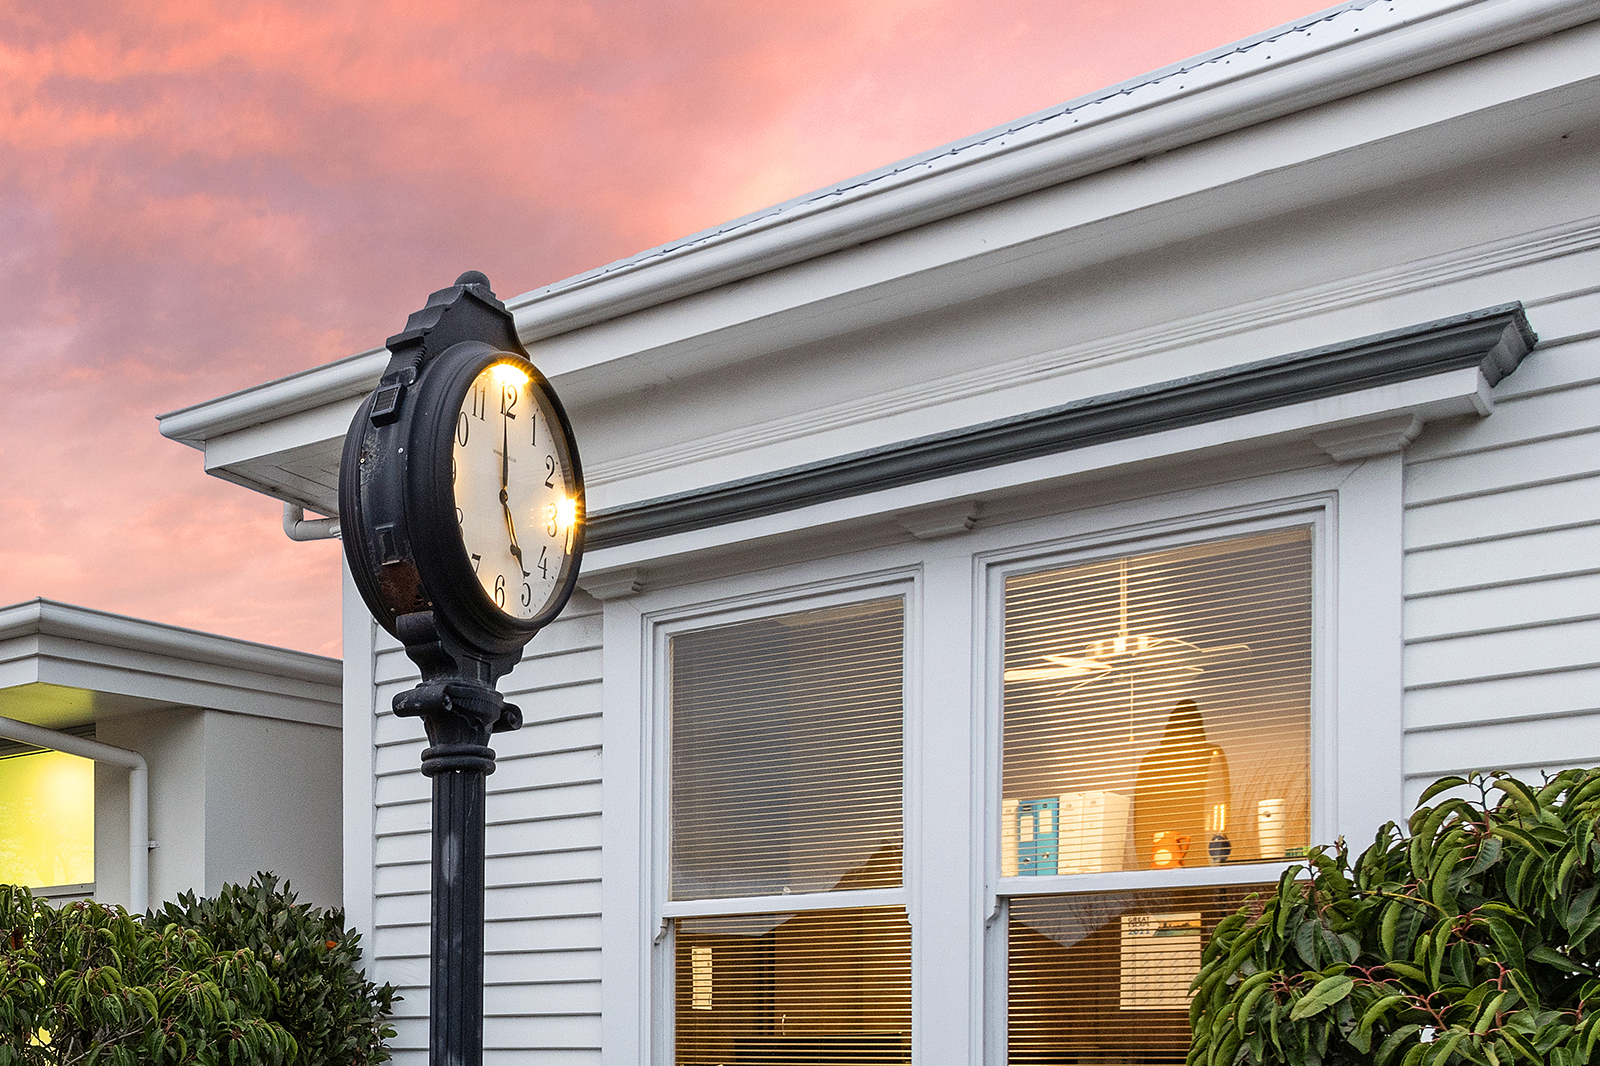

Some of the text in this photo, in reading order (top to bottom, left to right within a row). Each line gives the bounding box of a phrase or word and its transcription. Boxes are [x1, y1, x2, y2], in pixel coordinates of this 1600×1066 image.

[472, 384, 485, 421] 11
[500, 382, 517, 420] 12
[455, 411, 469, 447] 0
[531, 414, 536, 446] 1
[545, 455, 555, 489] 2
[547, 502, 558, 537] 3
[537, 545, 548, 579] 4
[495, 574, 505, 608] 6
[521, 570, 531, 607] 5
